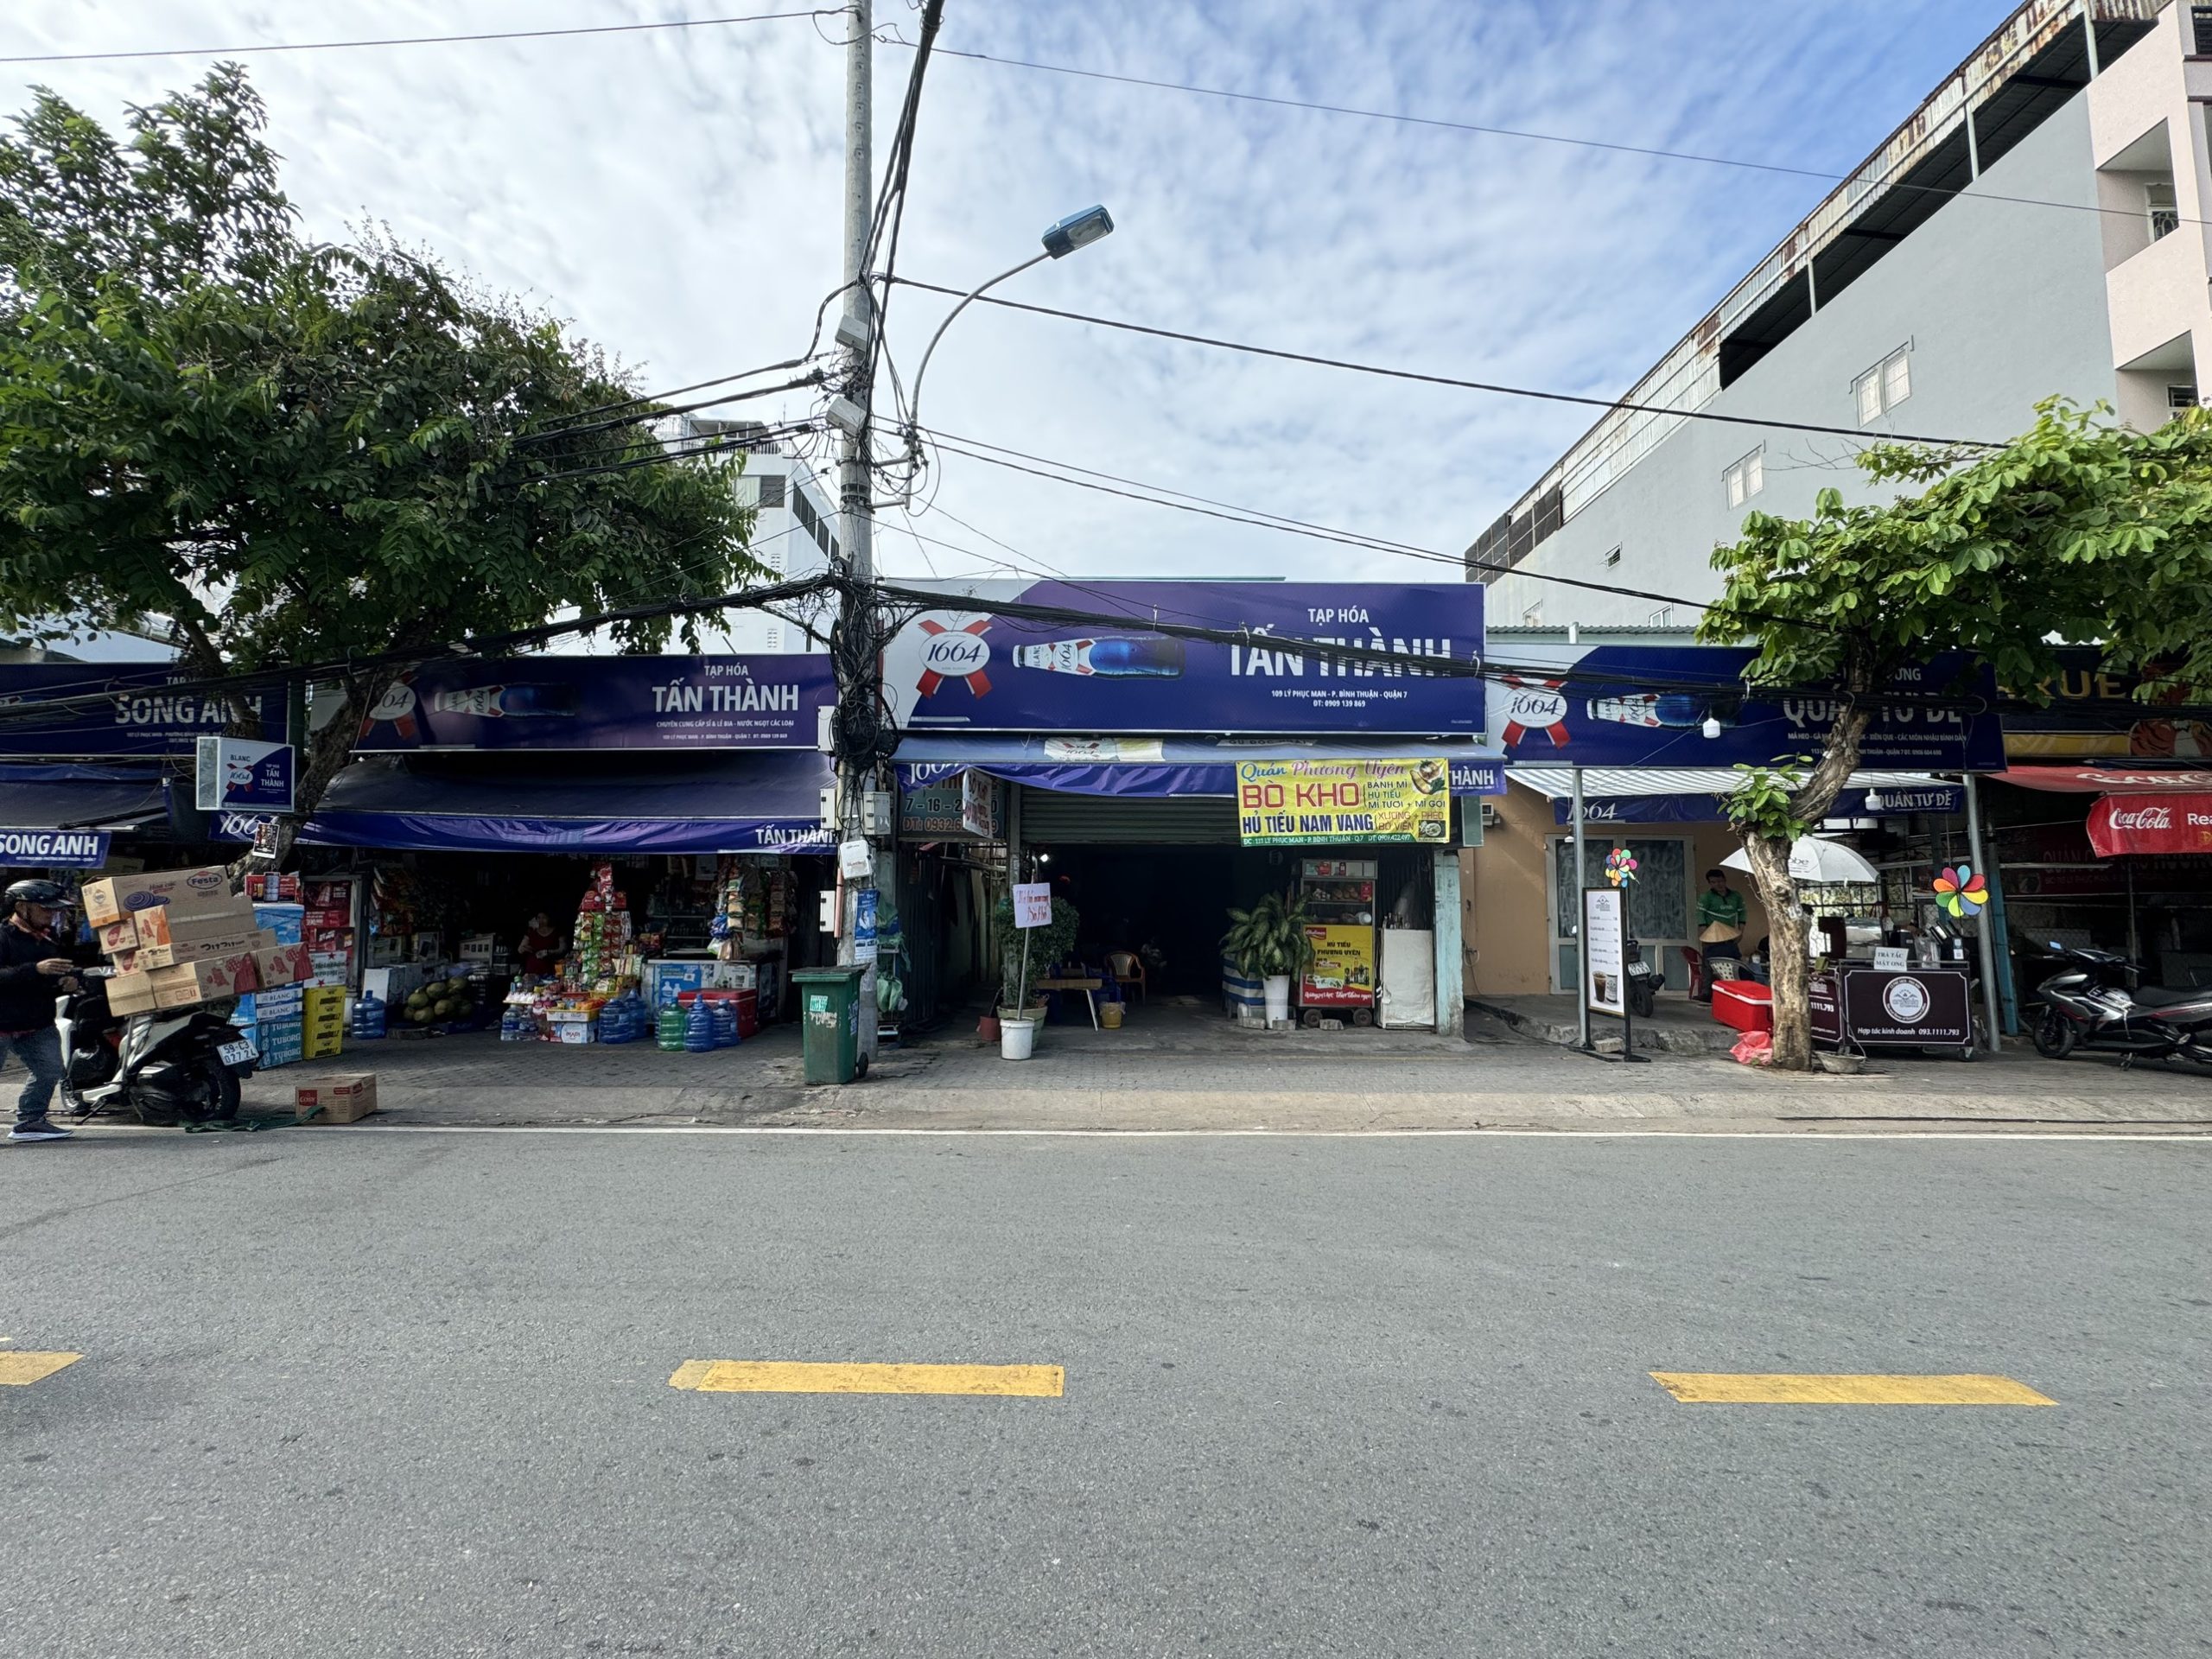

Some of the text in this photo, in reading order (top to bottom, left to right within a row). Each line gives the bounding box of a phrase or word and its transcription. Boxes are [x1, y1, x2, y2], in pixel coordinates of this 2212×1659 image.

[1307, 605, 1370, 626] TẠP HÓA
[926, 639, 986, 663] 1664
[703, 662, 749, 679] TẠP HÓA
[652, 677, 799, 713] TẤN THÀNH
[1284, 688, 1292, 697] LÝ
[1293, 690, 1310, 699] PHỤC
[1339, 689, 1356, 698] BÌNH
[1356, 690, 1379, 700] THUẬN
[1383, 690, 1402, 700] QUẬN
[115, 695, 195, 725] SONG
[678, 719, 694, 728] CUNG
[723, 719, 734, 728] BIA
[770, 717, 781, 727] CÁC
[230, 753, 251, 762] BLANC
[266, 767, 280, 778] TẤN
[1241, 759, 1406, 783] Quán Phương Uyên
[1449, 766, 1494, 785] HÀNH
[261, 778, 285, 788] THÀNH
[1242, 779, 1361, 809] BÒ KHO
[1878, 791, 1914, 811] UÁN
[906, 797, 914, 812] 7
[927, 797, 941, 812] 16
[1242, 810, 1374, 834] HỦ TIẾU NAM VANG
[2109, 807, 2172, 830] Coca-Cola
[755, 823, 786, 844] TẤN
[0, 834, 99, 855] SONG ANH
[191, 876, 219, 885] Festa
[269, 992, 291, 1001] BLANC
[269, 1006, 291, 1015] BLANC
[271, 1033, 302, 1046] TUBORG
[1857, 1027, 1871, 1036] Hợp
[1895, 1027, 1916, 1036] doanh
[223, 1040, 250, 1054] 59-C3
[273, 1046, 302, 1060] TUBORG
